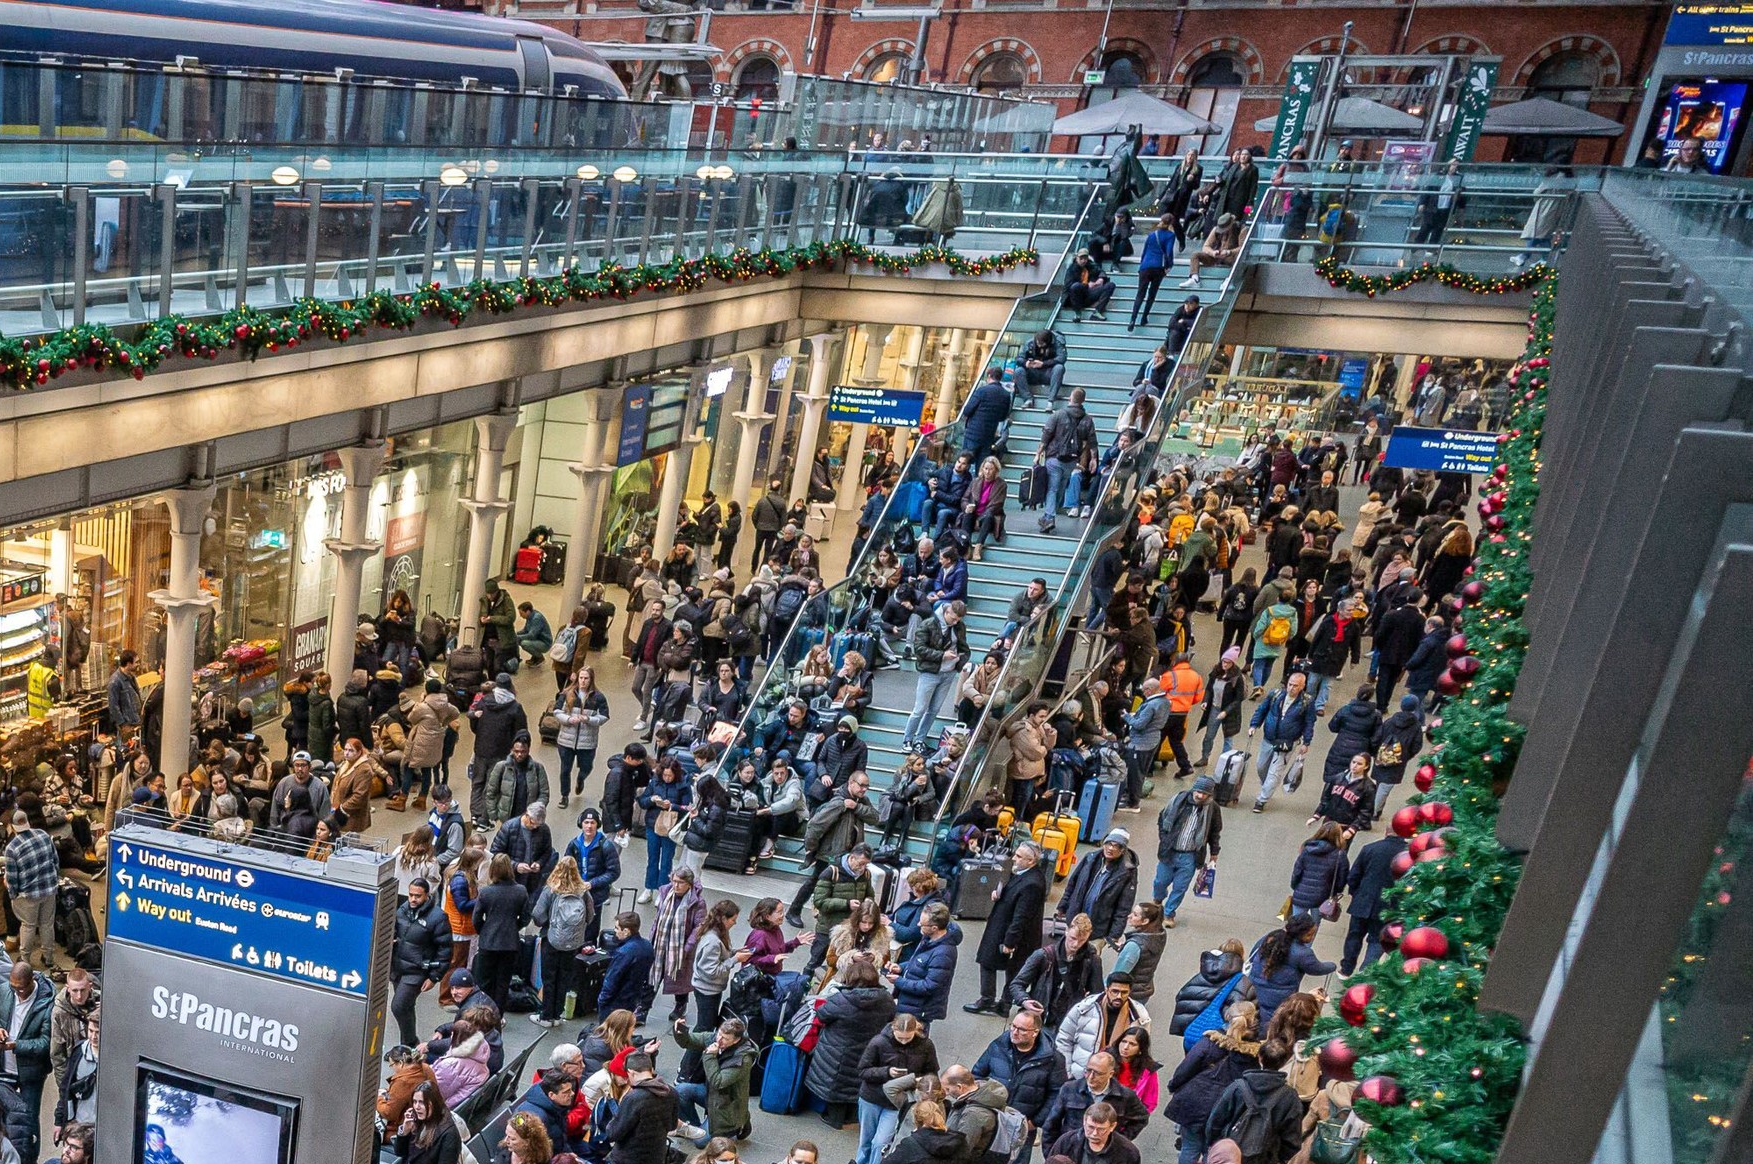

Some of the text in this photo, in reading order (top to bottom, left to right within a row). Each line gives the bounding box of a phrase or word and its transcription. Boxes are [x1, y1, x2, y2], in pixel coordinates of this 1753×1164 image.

[138, 849, 231, 883] Underground
[137, 874, 312, 923] Arrivals Arrivées eurostar
[137, 898, 237, 934] Way out Euston Road
[286, 956, 337, 983] Toilets
[220, 1039, 296, 1064] INTERNATIONAL
